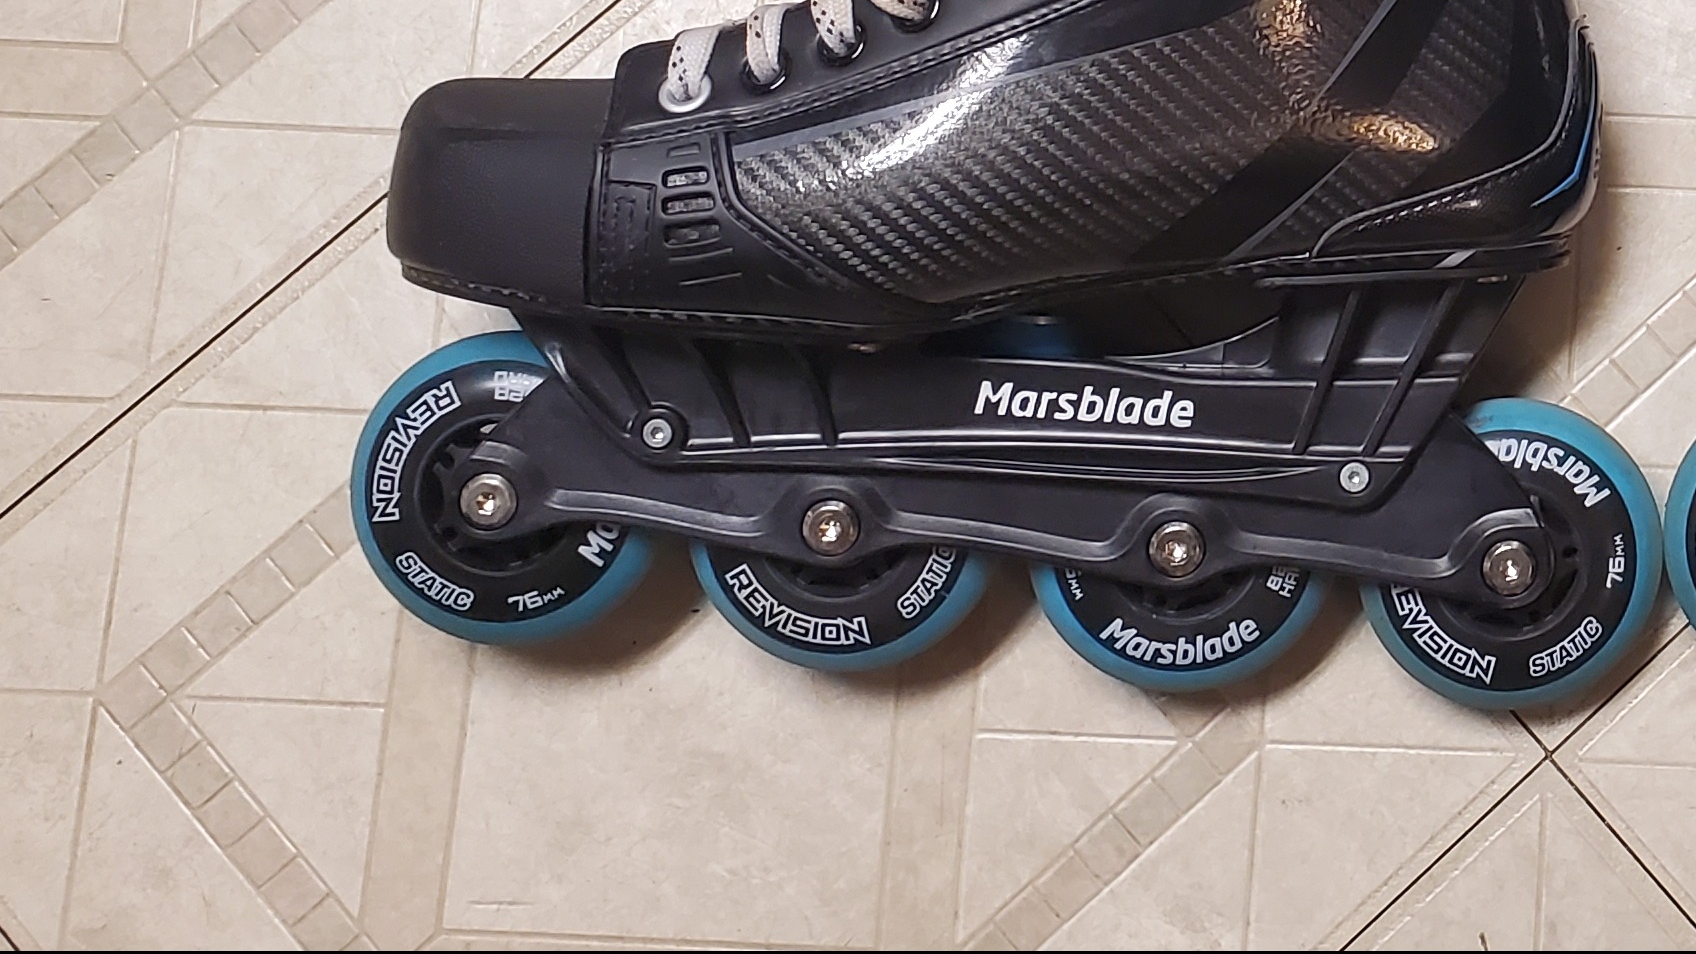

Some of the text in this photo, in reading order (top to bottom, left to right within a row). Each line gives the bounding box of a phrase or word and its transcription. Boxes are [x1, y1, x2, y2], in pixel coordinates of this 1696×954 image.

[974, 380, 1195, 428] Marsblade
[371, 380, 462, 522] REVISION
[395, 551, 474, 611] STATIC
[724, 563, 872, 646] REVISION
[1278, 567, 1300, 598] HA
[1099, 617, 1261, 666] Marsblade
[1390, 583, 1496, 685] EVISION
[1529, 616, 1603, 678] STATIC
